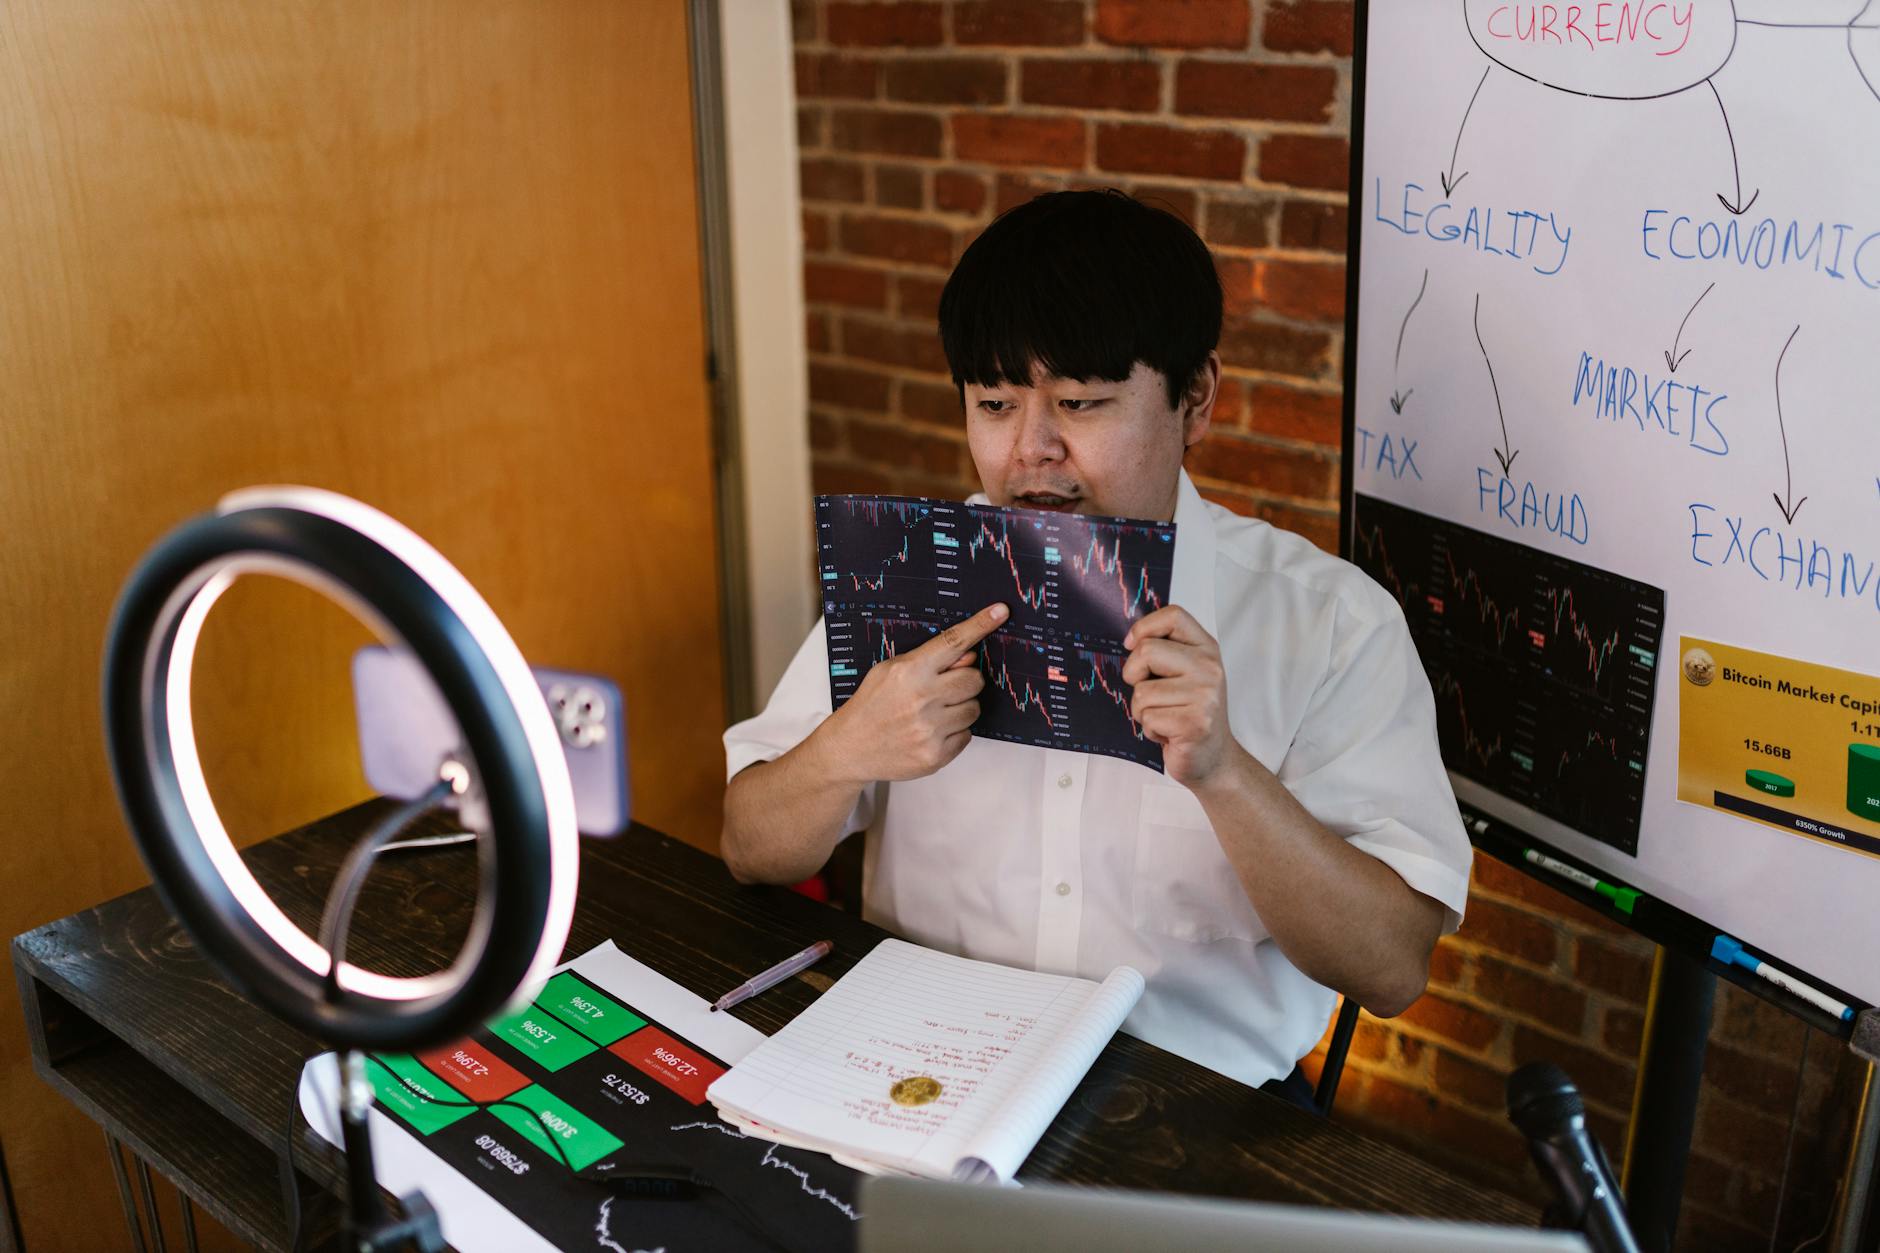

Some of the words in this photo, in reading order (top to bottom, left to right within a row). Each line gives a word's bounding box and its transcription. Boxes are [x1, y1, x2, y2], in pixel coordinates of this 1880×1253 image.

[1487, 1, 1693, 56] CURRENCY
[1376, 177, 1571, 275] LEGALITY
[1573, 350, 1729, 456] MARKETS
[1356, 426, 1423, 481] TAX
[1477, 466, 1588, 545] FRAUD
[1688, 503, 1880, 612] EXCHAN
[1722, 667, 1772, 690] Bitcoin
[1777, 680, 1836, 705] Market
[1744, 738, 1792, 760] 15.66B
[1765, 783, 1778, 792] 2017
[1795, 819, 1818, 833] 6350%
[1819, 826, 1846, 840] Growth
[572, 997, 604, 1018] 4.13%
[521, 1021, 556, 1043] 1.53%
[452, 1050, 488, 1076] -2.19%
[652, 1048, 699, 1076] -12.96%
[602, 1074, 650, 1105] $153.75
[539, 1111, 578, 1138] 3.00%
[475, 1135, 530, 1175] $7569.08
